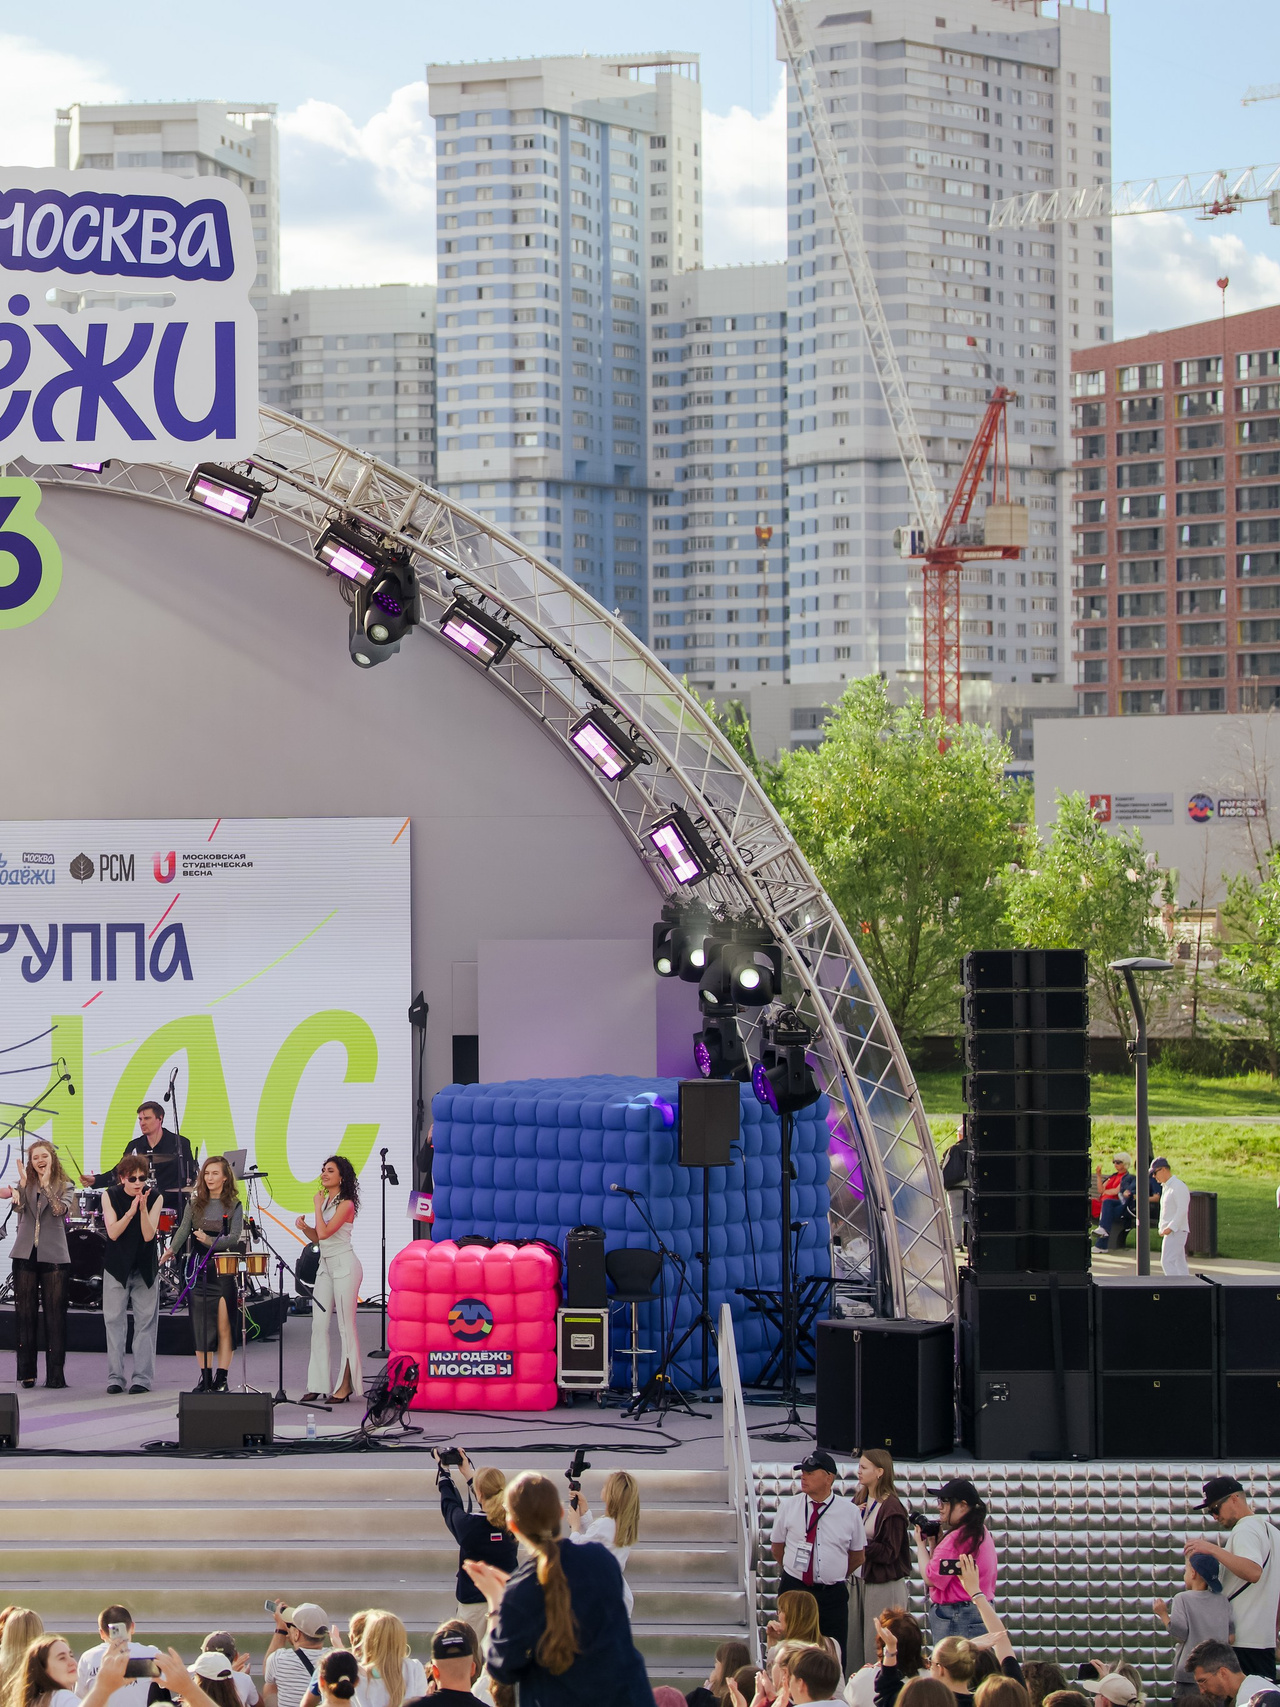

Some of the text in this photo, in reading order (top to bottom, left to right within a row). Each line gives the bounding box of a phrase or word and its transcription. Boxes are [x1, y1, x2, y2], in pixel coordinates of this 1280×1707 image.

[99, 854, 135, 882] РСМ
[430, 1350, 512, 1362] МОЛОДЁЖЬ
[430, 1364, 512, 1376] МОСКВЫ
